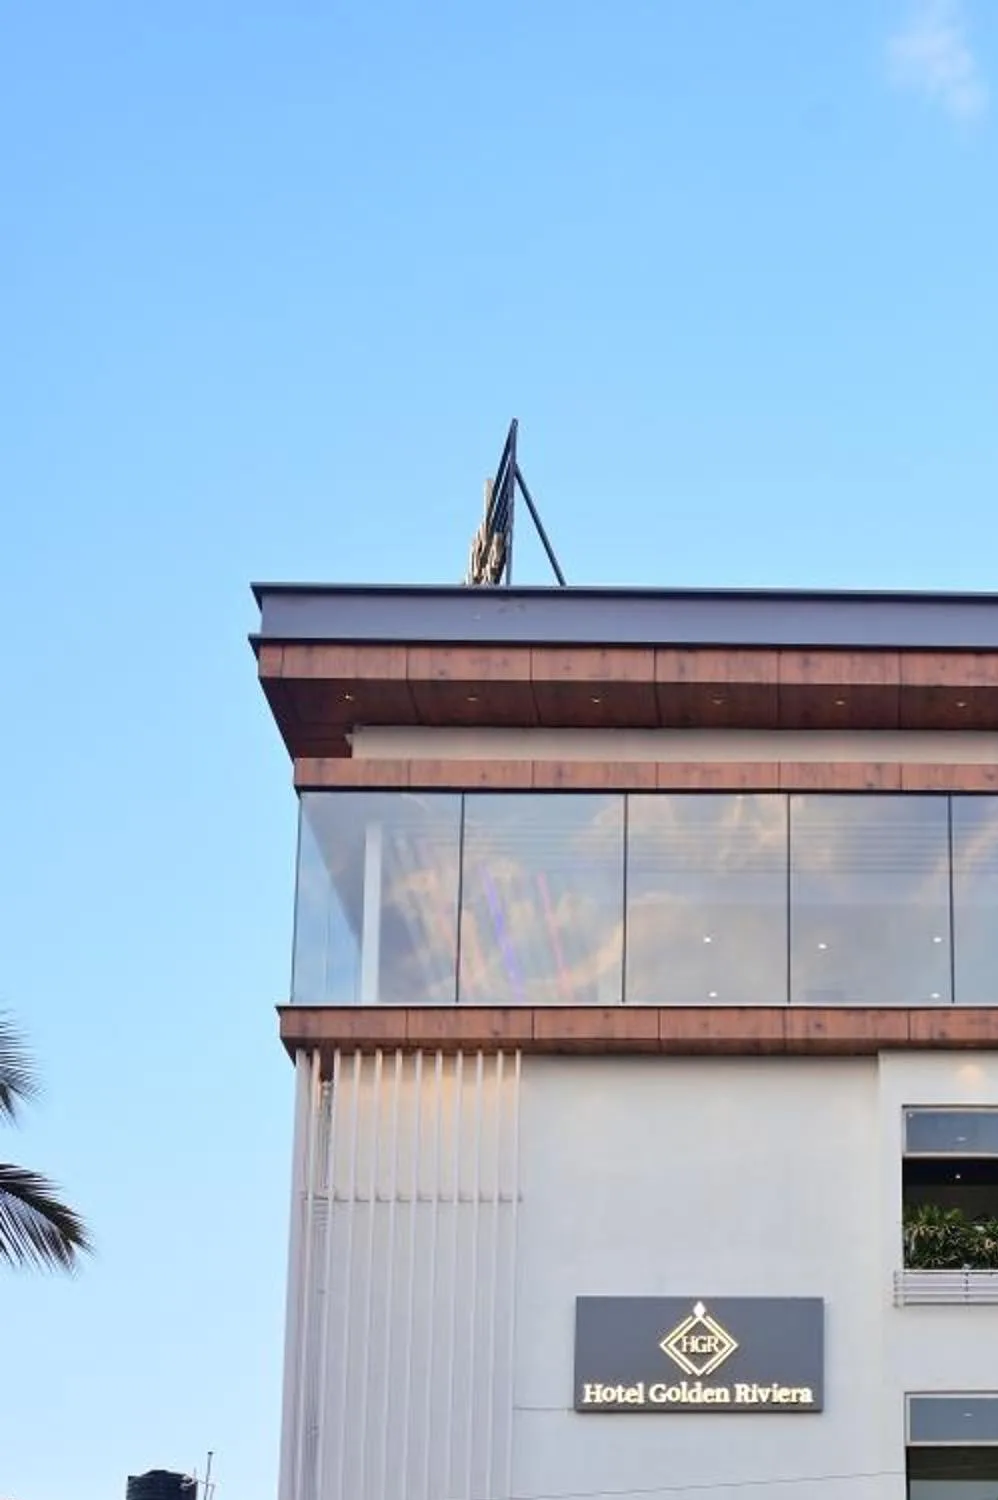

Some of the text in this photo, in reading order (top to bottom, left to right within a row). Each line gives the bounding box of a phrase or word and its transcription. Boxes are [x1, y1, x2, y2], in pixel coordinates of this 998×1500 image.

[681, 1335, 720, 1353] HGR
[583, 1382, 814, 1404] Hotel Golden Riviera
